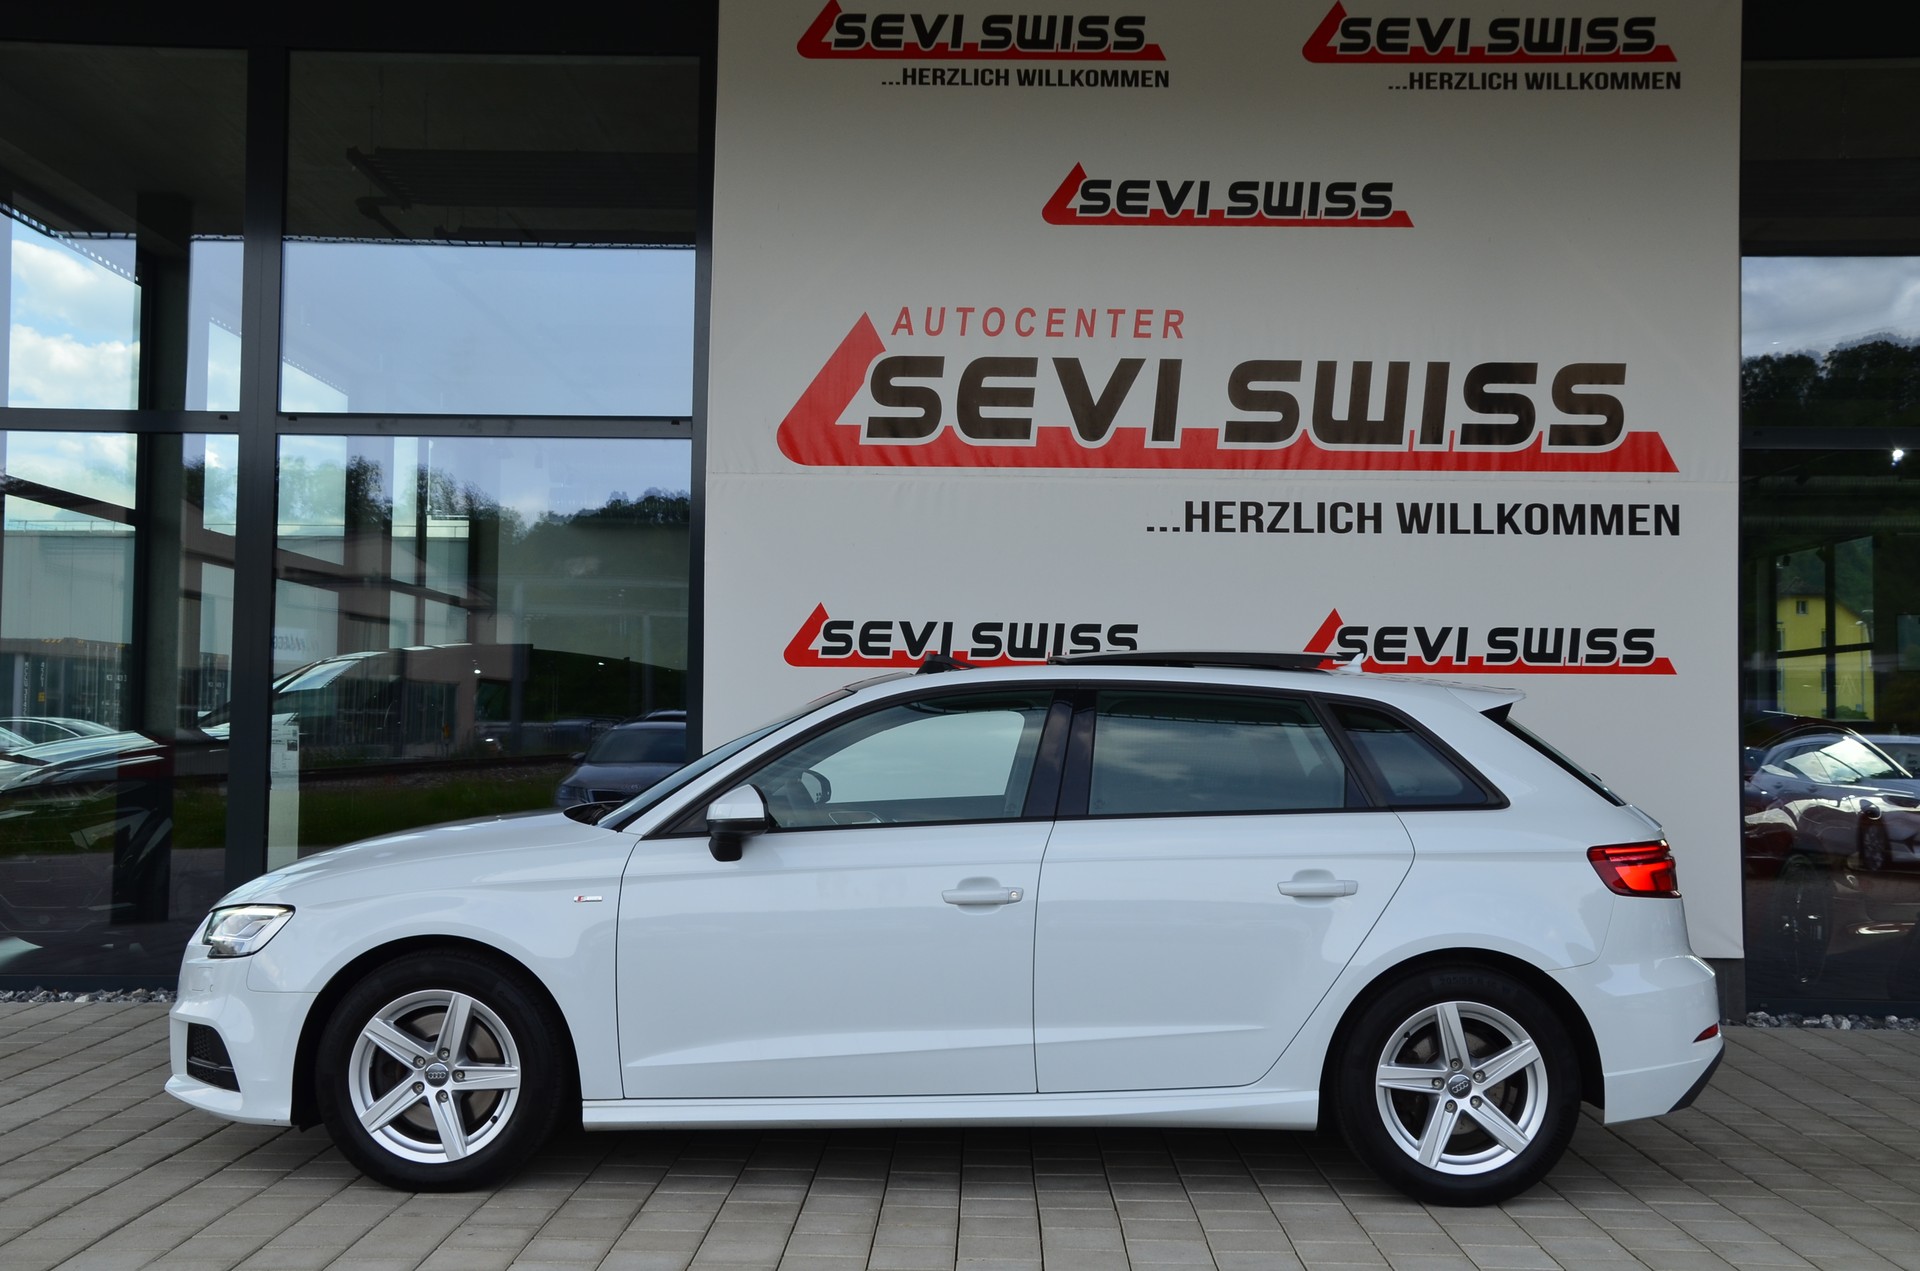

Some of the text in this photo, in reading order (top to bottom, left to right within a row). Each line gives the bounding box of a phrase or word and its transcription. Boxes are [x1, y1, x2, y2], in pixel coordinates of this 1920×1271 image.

[833, 13, 1146, 51] SEVI SWISS
[1339, 17, 1656, 54] SEVI SWISS
[1017, 69, 1169, 88] WILLKOMMEN
[1525, 72, 1681, 90] WILLKOMMEN
[1078, 179, 1394, 217] SEVI SWISS
[891, 307, 1185, 338] AUTOCENTER
[866, 355, 1627, 446] SEVI SWISS
[1396, 503, 1680, 536] WILLKOMMEN
[821, 620, 1138, 658] SEVI SWISS
[1337, 626, 1655, 664] SEVI SWISS
